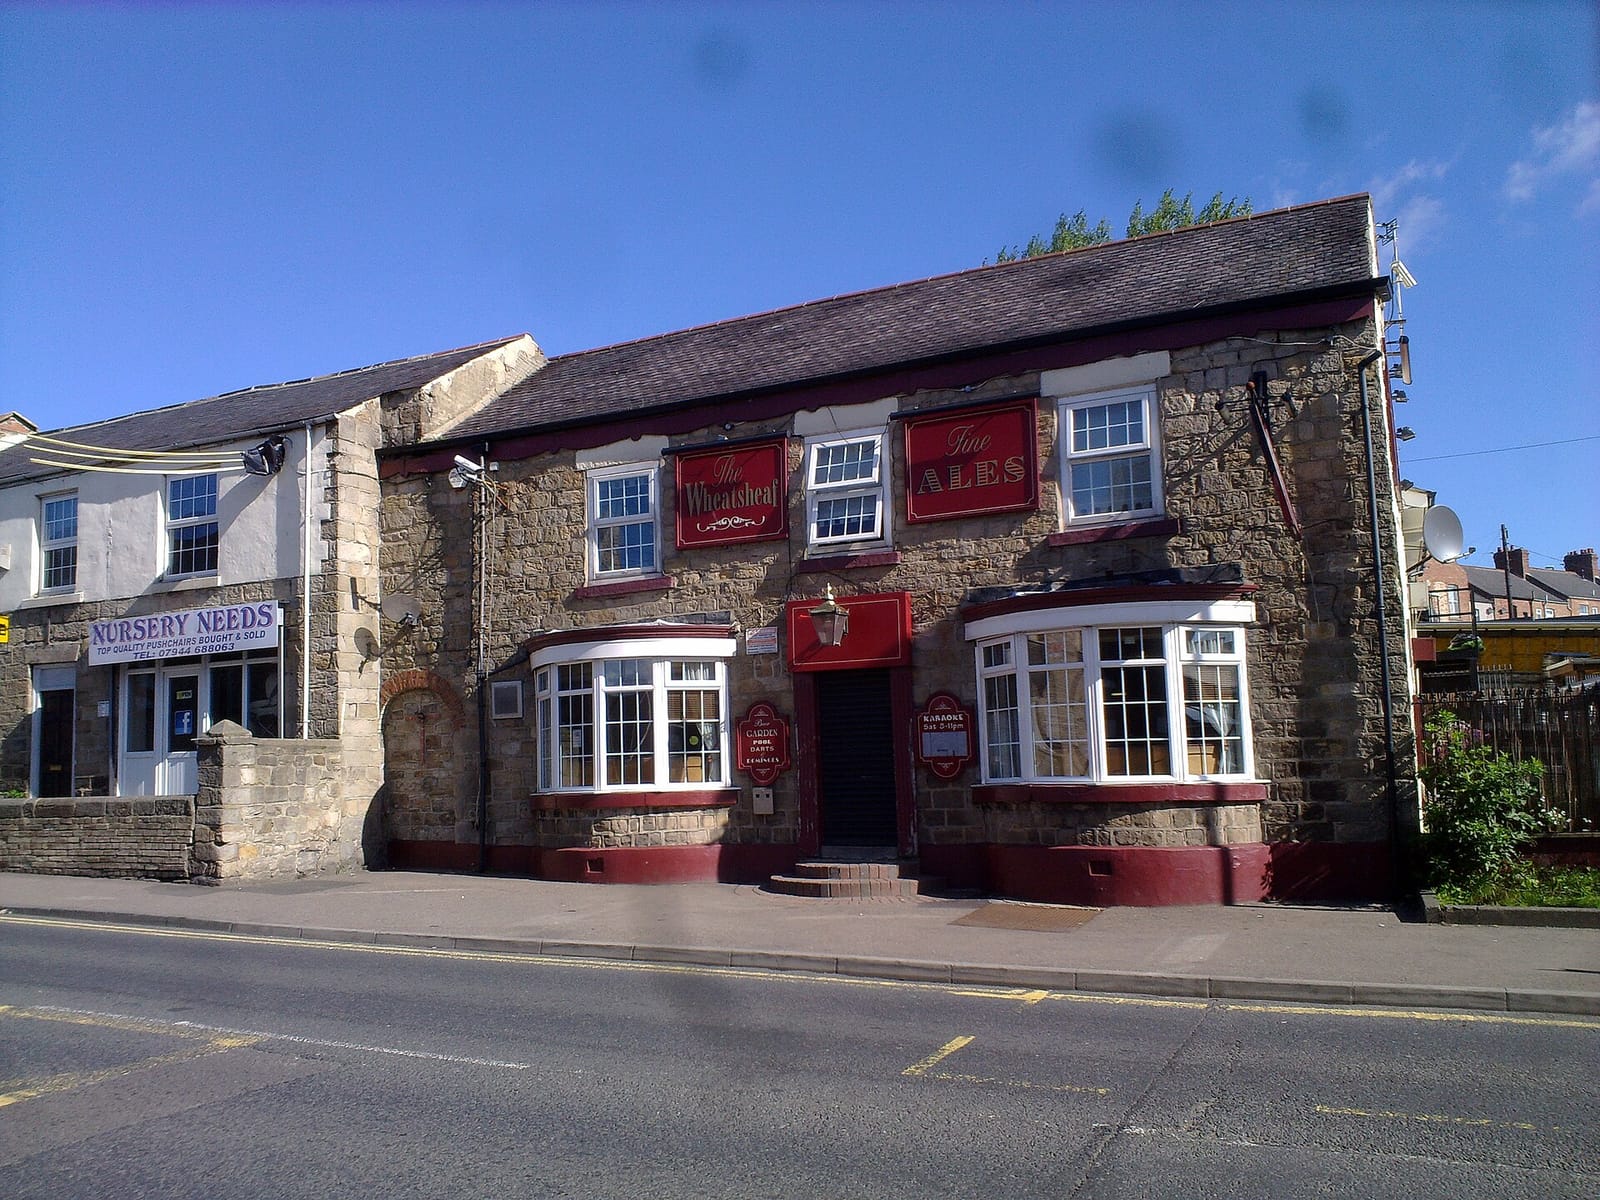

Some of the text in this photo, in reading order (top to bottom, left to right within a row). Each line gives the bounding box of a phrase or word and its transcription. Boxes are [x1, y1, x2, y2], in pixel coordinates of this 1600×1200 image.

[945, 424, 991, 457] Fine
[713, 455, 744, 488] The
[917, 456, 1025, 495] ALES
[684, 478, 779, 518] Wheatsheaf
[92, 604, 274, 646] NURSERY NEEDS
[97, 630, 266, 655] TOP QUALITY PUSHCHAIRS BOUGHT & SOLD
[133, 642, 235, 660] TEL: 07944 688063
[923, 713, 964, 722] KARAOKE
[923, 723, 936, 731] Sat
[746, 728, 778, 738] GARDEN
[750, 745, 775, 753] DARTS
